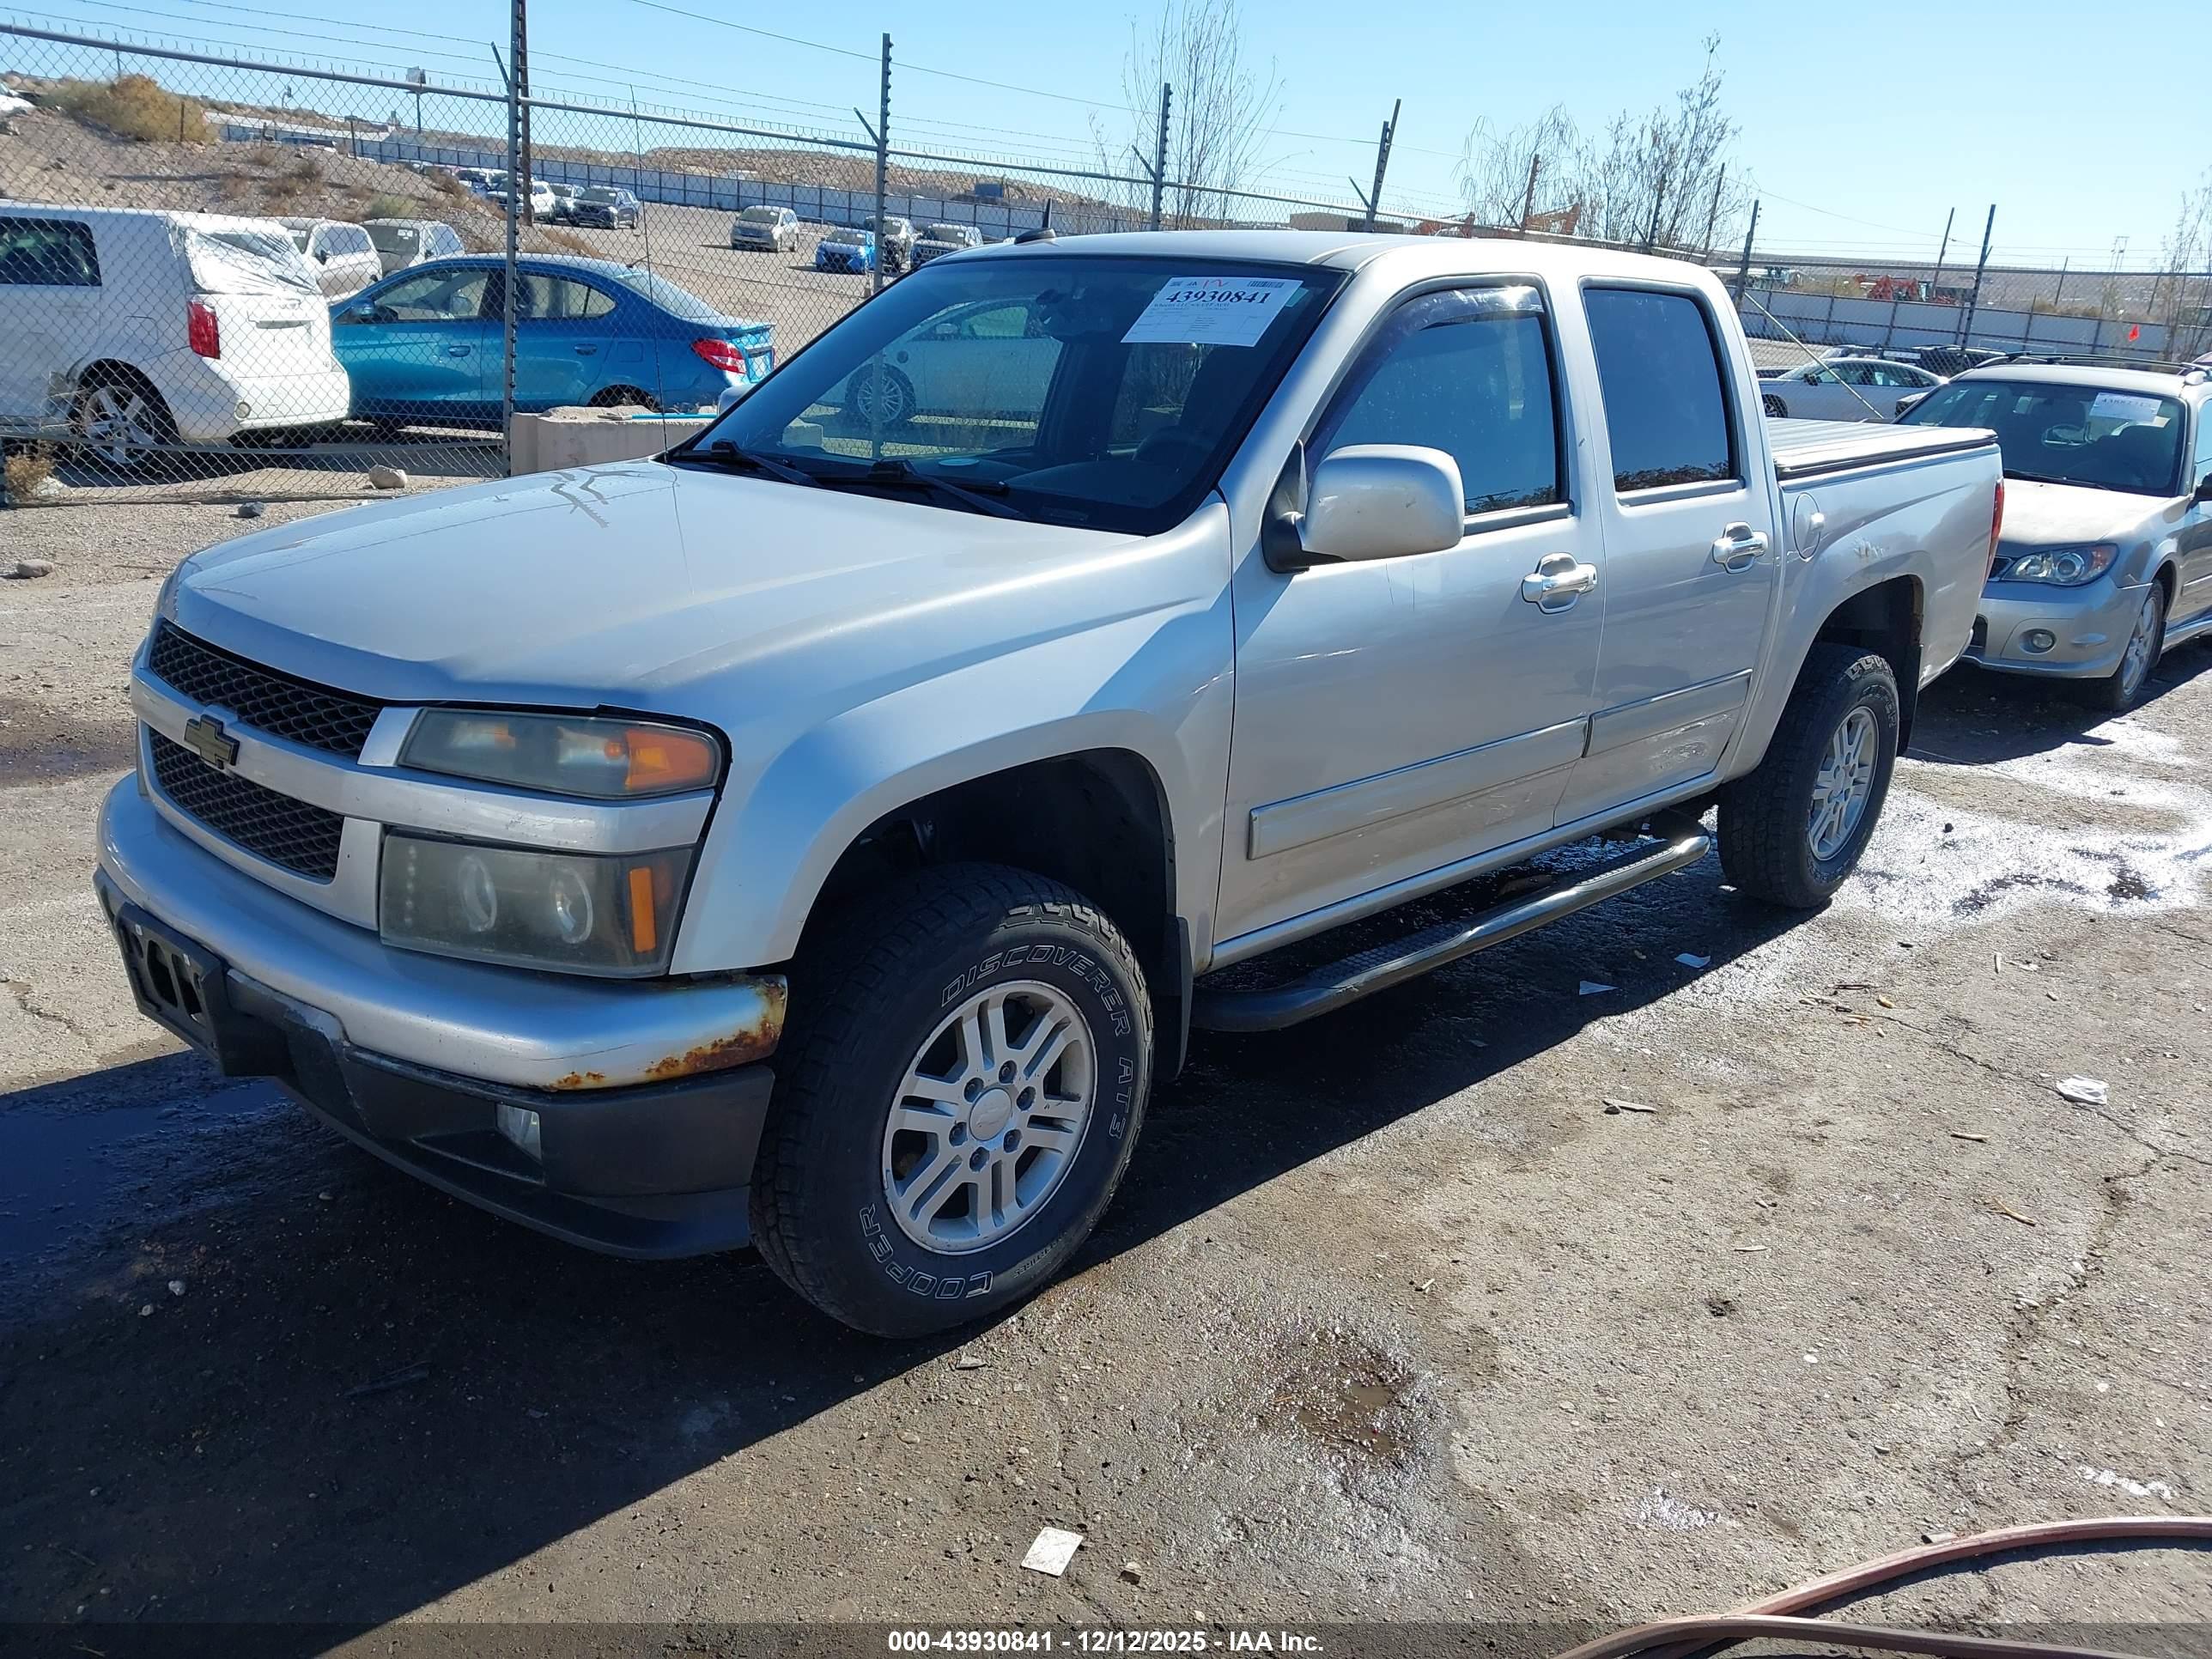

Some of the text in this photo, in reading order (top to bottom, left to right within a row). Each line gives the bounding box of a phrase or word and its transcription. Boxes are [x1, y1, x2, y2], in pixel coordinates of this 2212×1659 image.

[1166, 290, 1271, 304] 43930841
[941, 945, 1133, 1139] DISCOVERER AT3
[859, 1203, 994, 1299] COOPER
